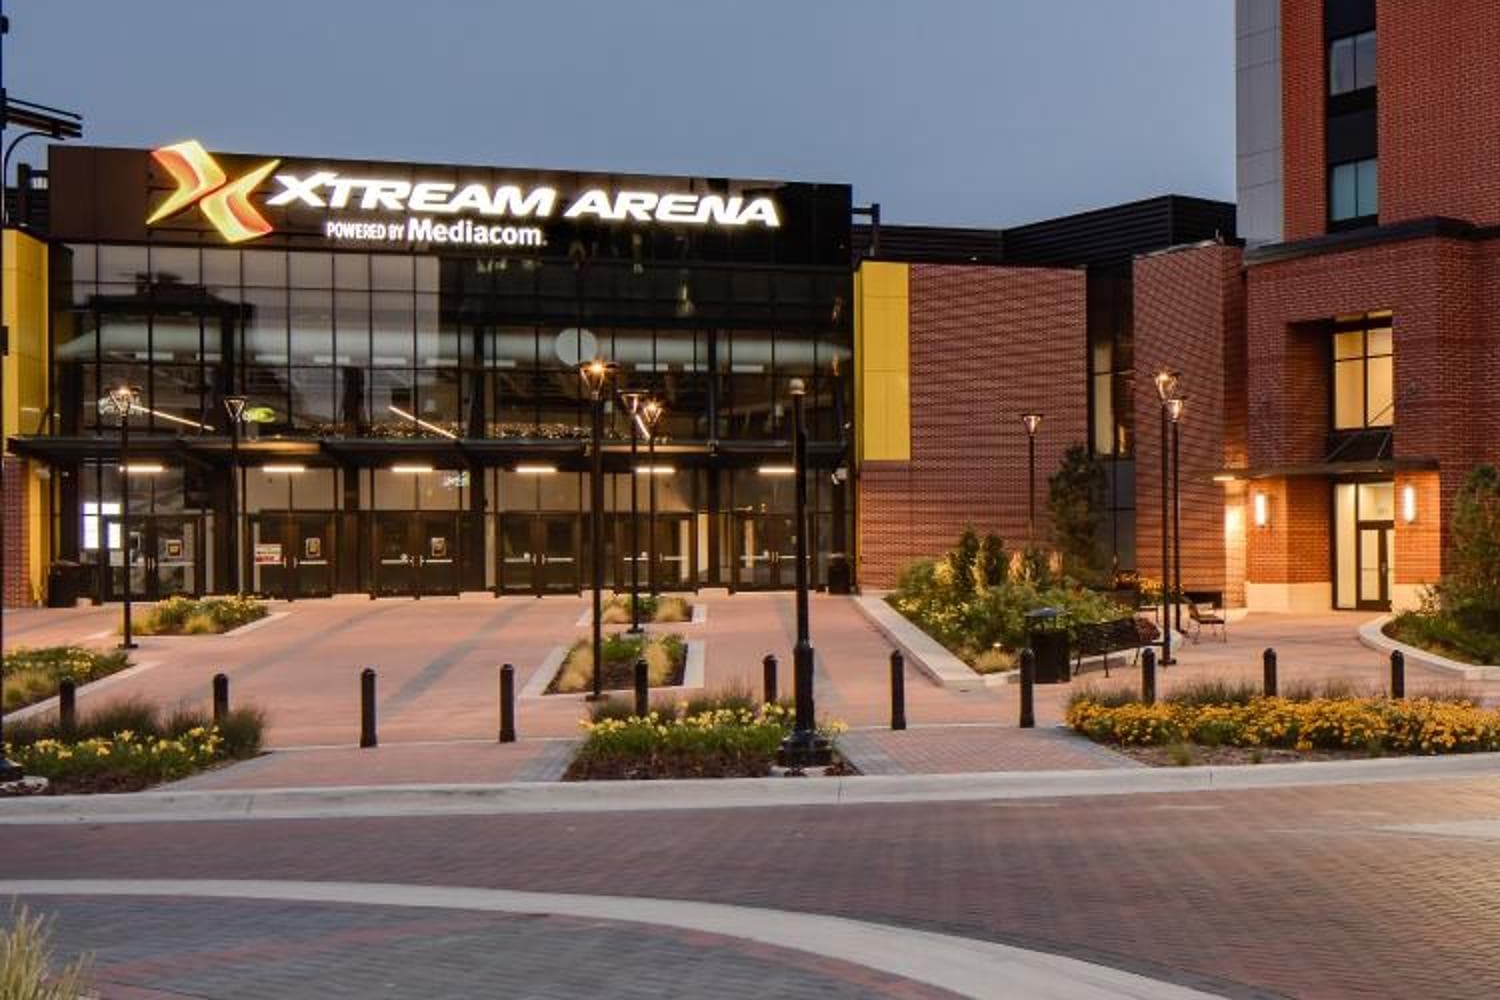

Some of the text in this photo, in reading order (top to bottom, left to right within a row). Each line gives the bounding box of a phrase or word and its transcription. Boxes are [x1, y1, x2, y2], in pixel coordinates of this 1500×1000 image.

[266, 171, 781, 227] XTREAM ARENA
[326, 221, 386, 240] POWERED
[388, 225, 404, 240] BY
